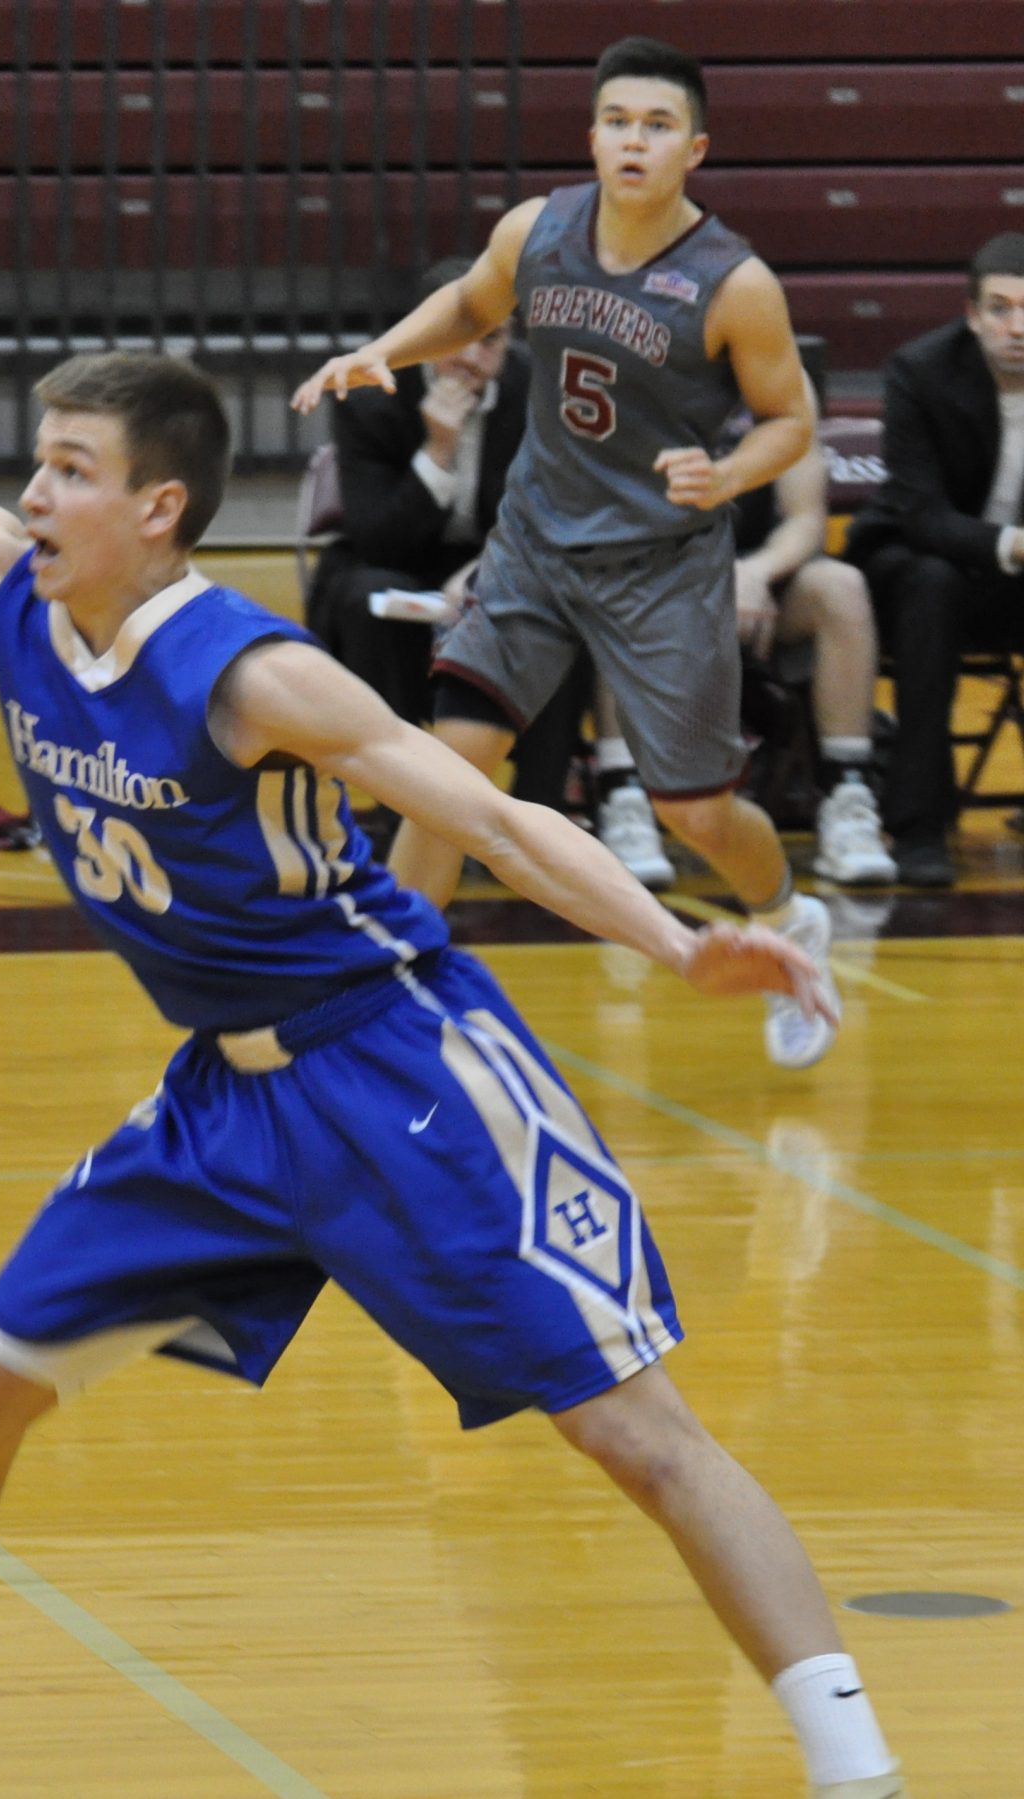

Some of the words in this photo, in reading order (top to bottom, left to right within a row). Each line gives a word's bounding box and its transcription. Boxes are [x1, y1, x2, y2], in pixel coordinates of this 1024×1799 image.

[529, 284, 672, 367] BREWERS
[561, 348, 617, 442] 5
[6, 699, 189, 809] Hamilton
[54, 793, 172, 914] 30
[553, 1190, 607, 1247] H
